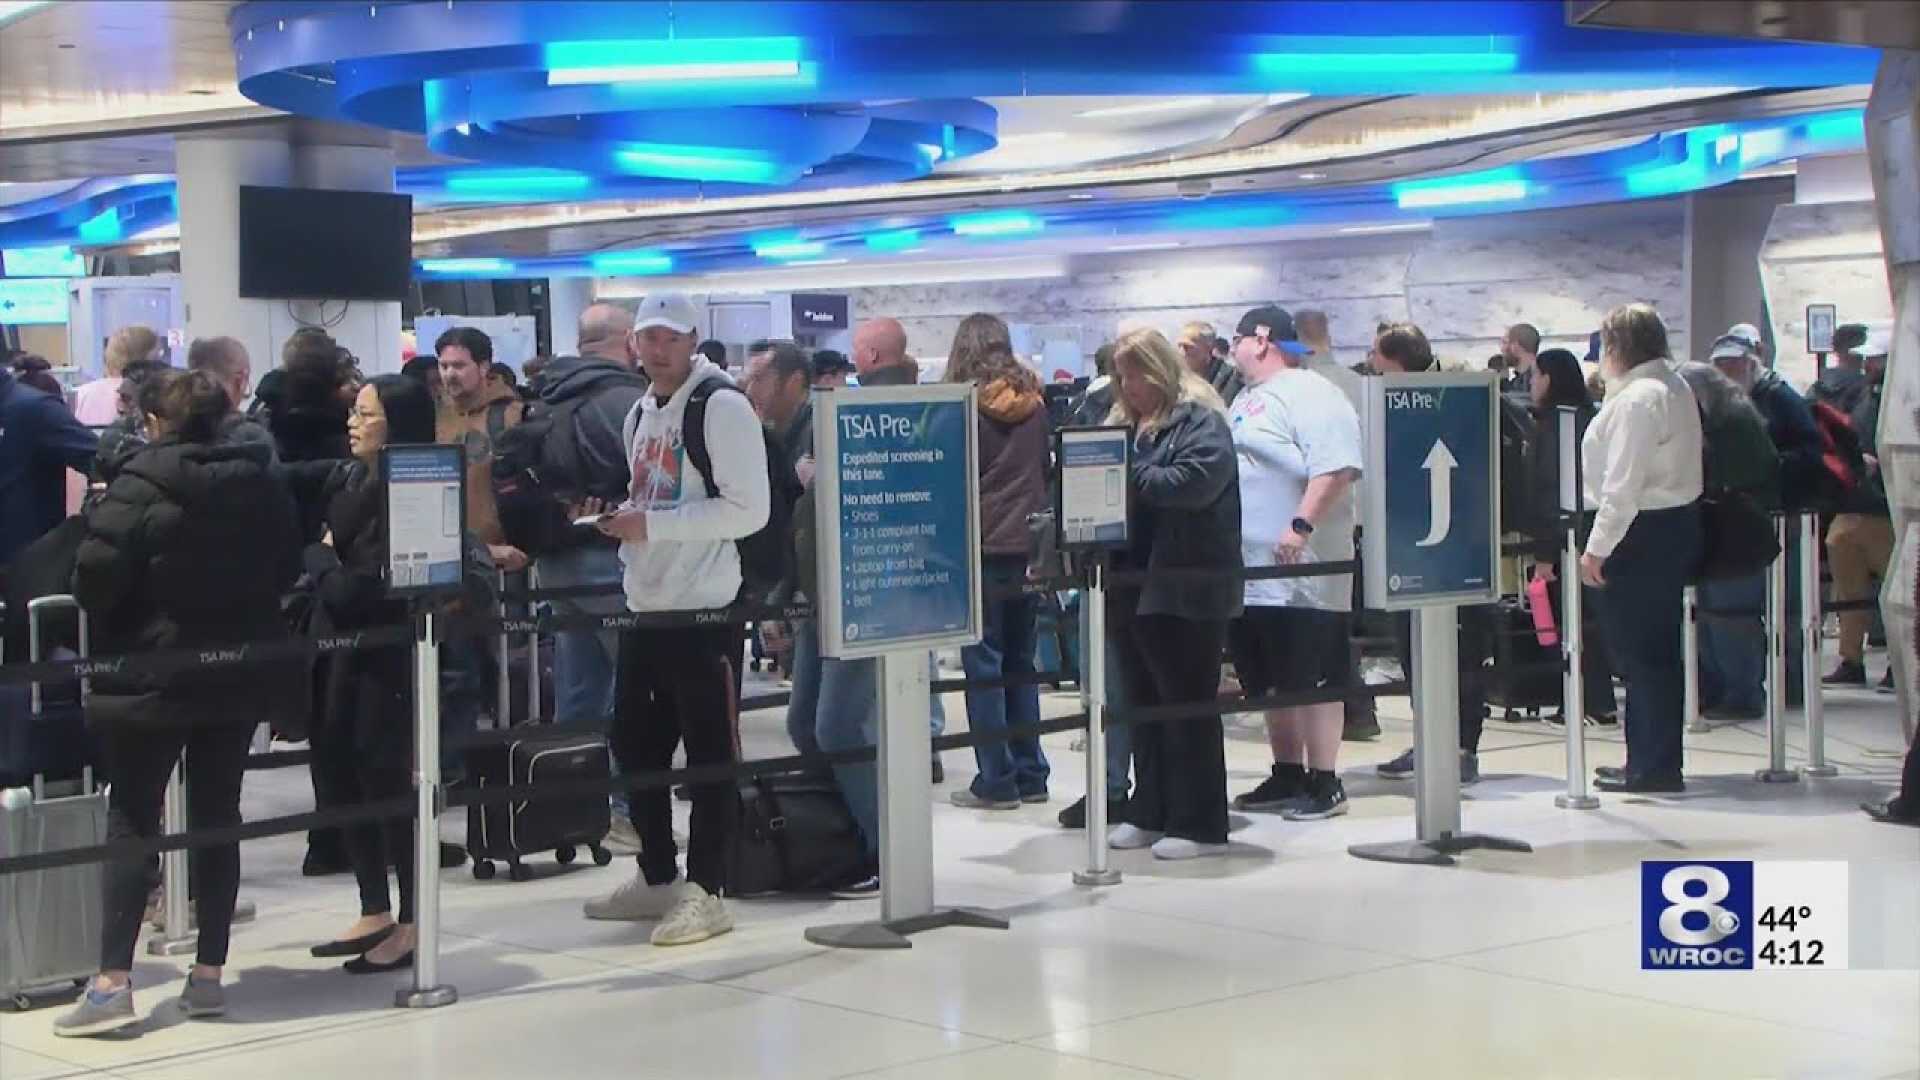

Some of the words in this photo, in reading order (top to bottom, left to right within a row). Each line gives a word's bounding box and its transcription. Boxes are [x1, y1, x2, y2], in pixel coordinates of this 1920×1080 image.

[1384, 392, 1411, 409] TSA
[1412, 391, 1433, 408] Pre
[839, 414, 877, 439] TSA
[879, 413, 911, 438] Pre
[842, 451, 889, 467] Expedited
[890, 449, 934, 464] screening
[935, 448, 944, 460] in
[842, 469, 862, 481] this
[863, 468, 885, 481] lane.
[842, 493, 859, 505] No
[860, 492, 883, 505] need
[884, 491, 895, 504] to
[851, 509, 880, 522] Shoes
[852, 543, 876, 557] from
[852, 560, 885, 574] Laptop
[852, 577, 877, 592] Light
[853, 594, 873, 608] Belt
